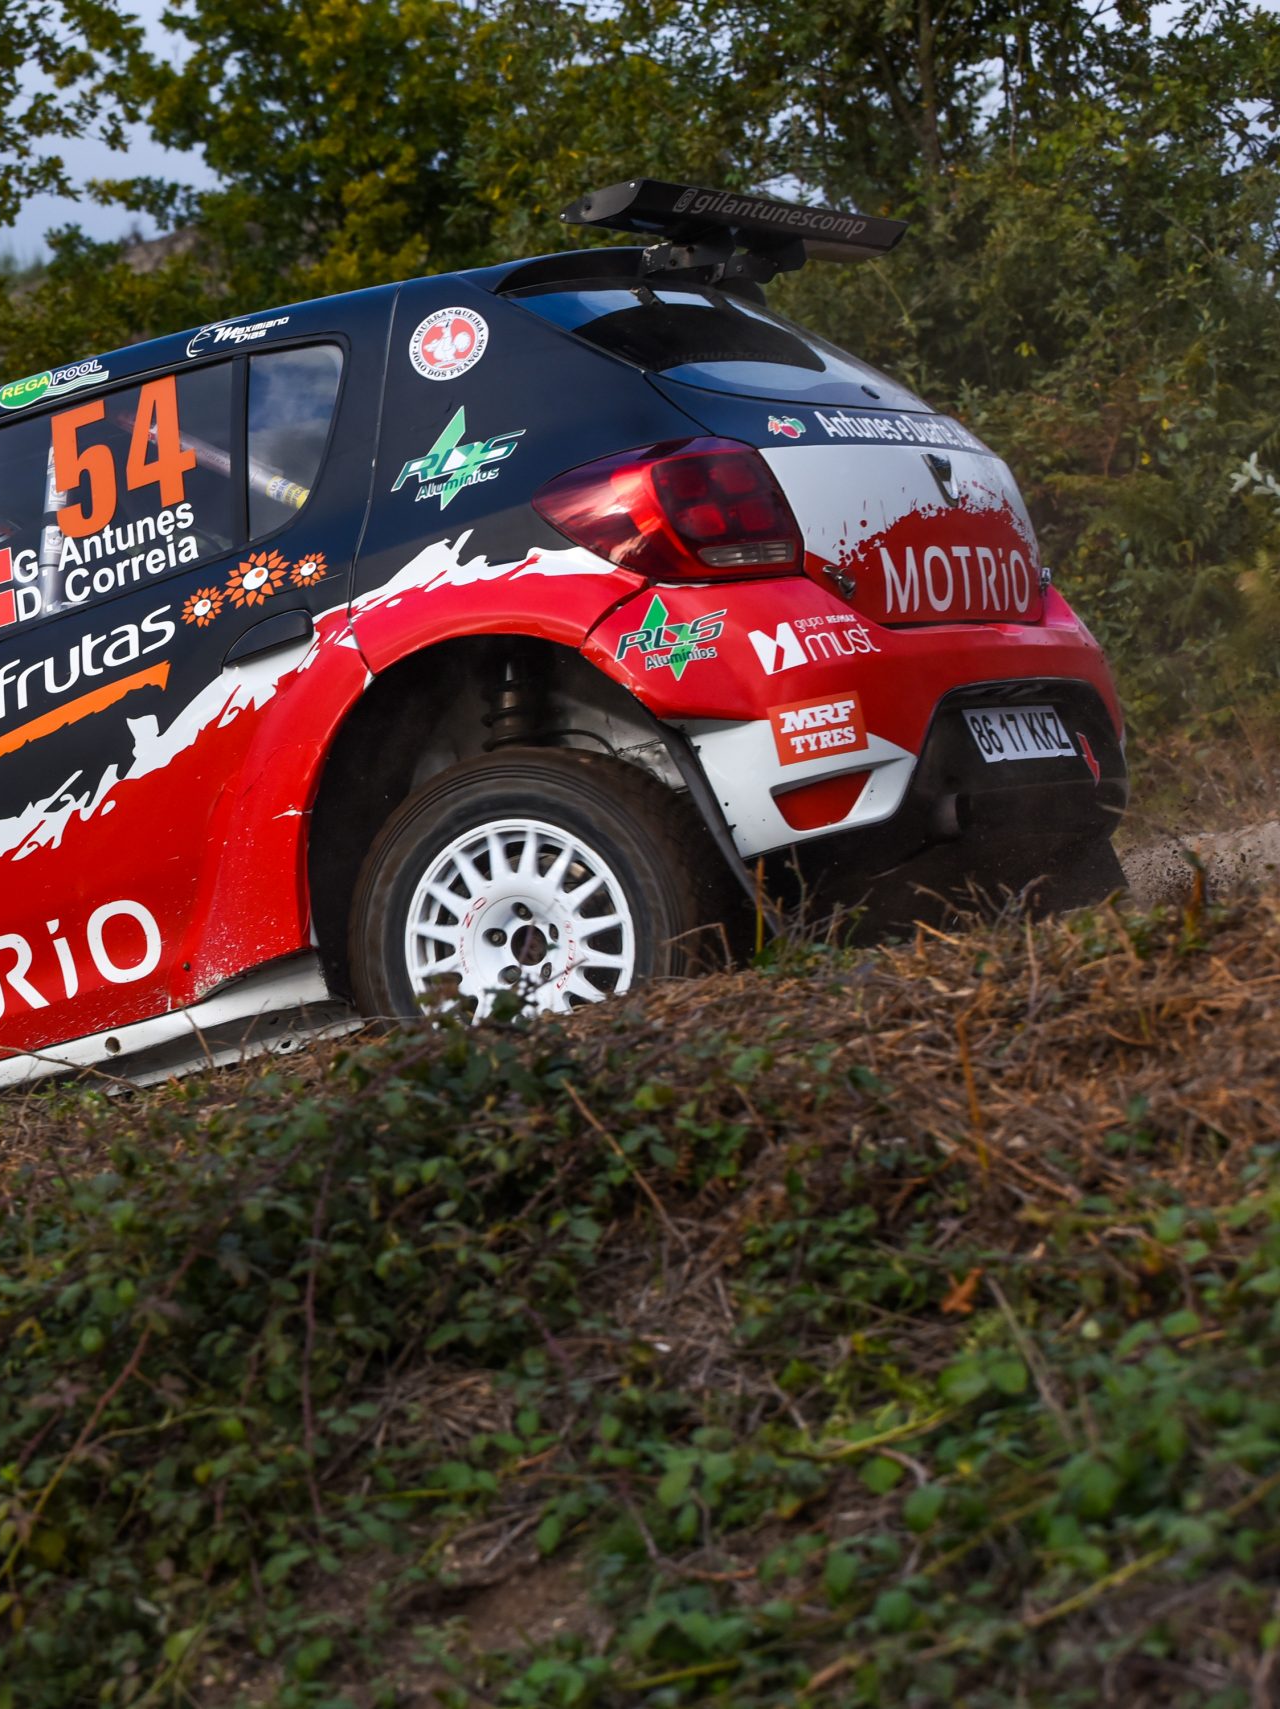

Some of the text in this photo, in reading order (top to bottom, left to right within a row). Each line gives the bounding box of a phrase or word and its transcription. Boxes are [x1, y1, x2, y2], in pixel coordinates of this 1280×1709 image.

[673, 188, 866, 238] @gilantunescomp
[213, 316, 290, 343] Maximiano
[234, 329, 267, 344] Dias
[413, 309, 484, 344] CHURRASQUEIRA
[427, 368, 447, 378] DOS
[450, 339, 485, 376] FRANGOS
[814, 411, 902, 441] Antunes
[51, 374, 197, 538] 54
[13, 503, 194, 584] G. Antunes
[16, 534, 200, 622] D. Correia
[794, 616, 824, 632] grupo
[805, 623, 881, 661] must
[779, 700, 855, 734] MRF
[790, 726, 856, 754] TYRES
